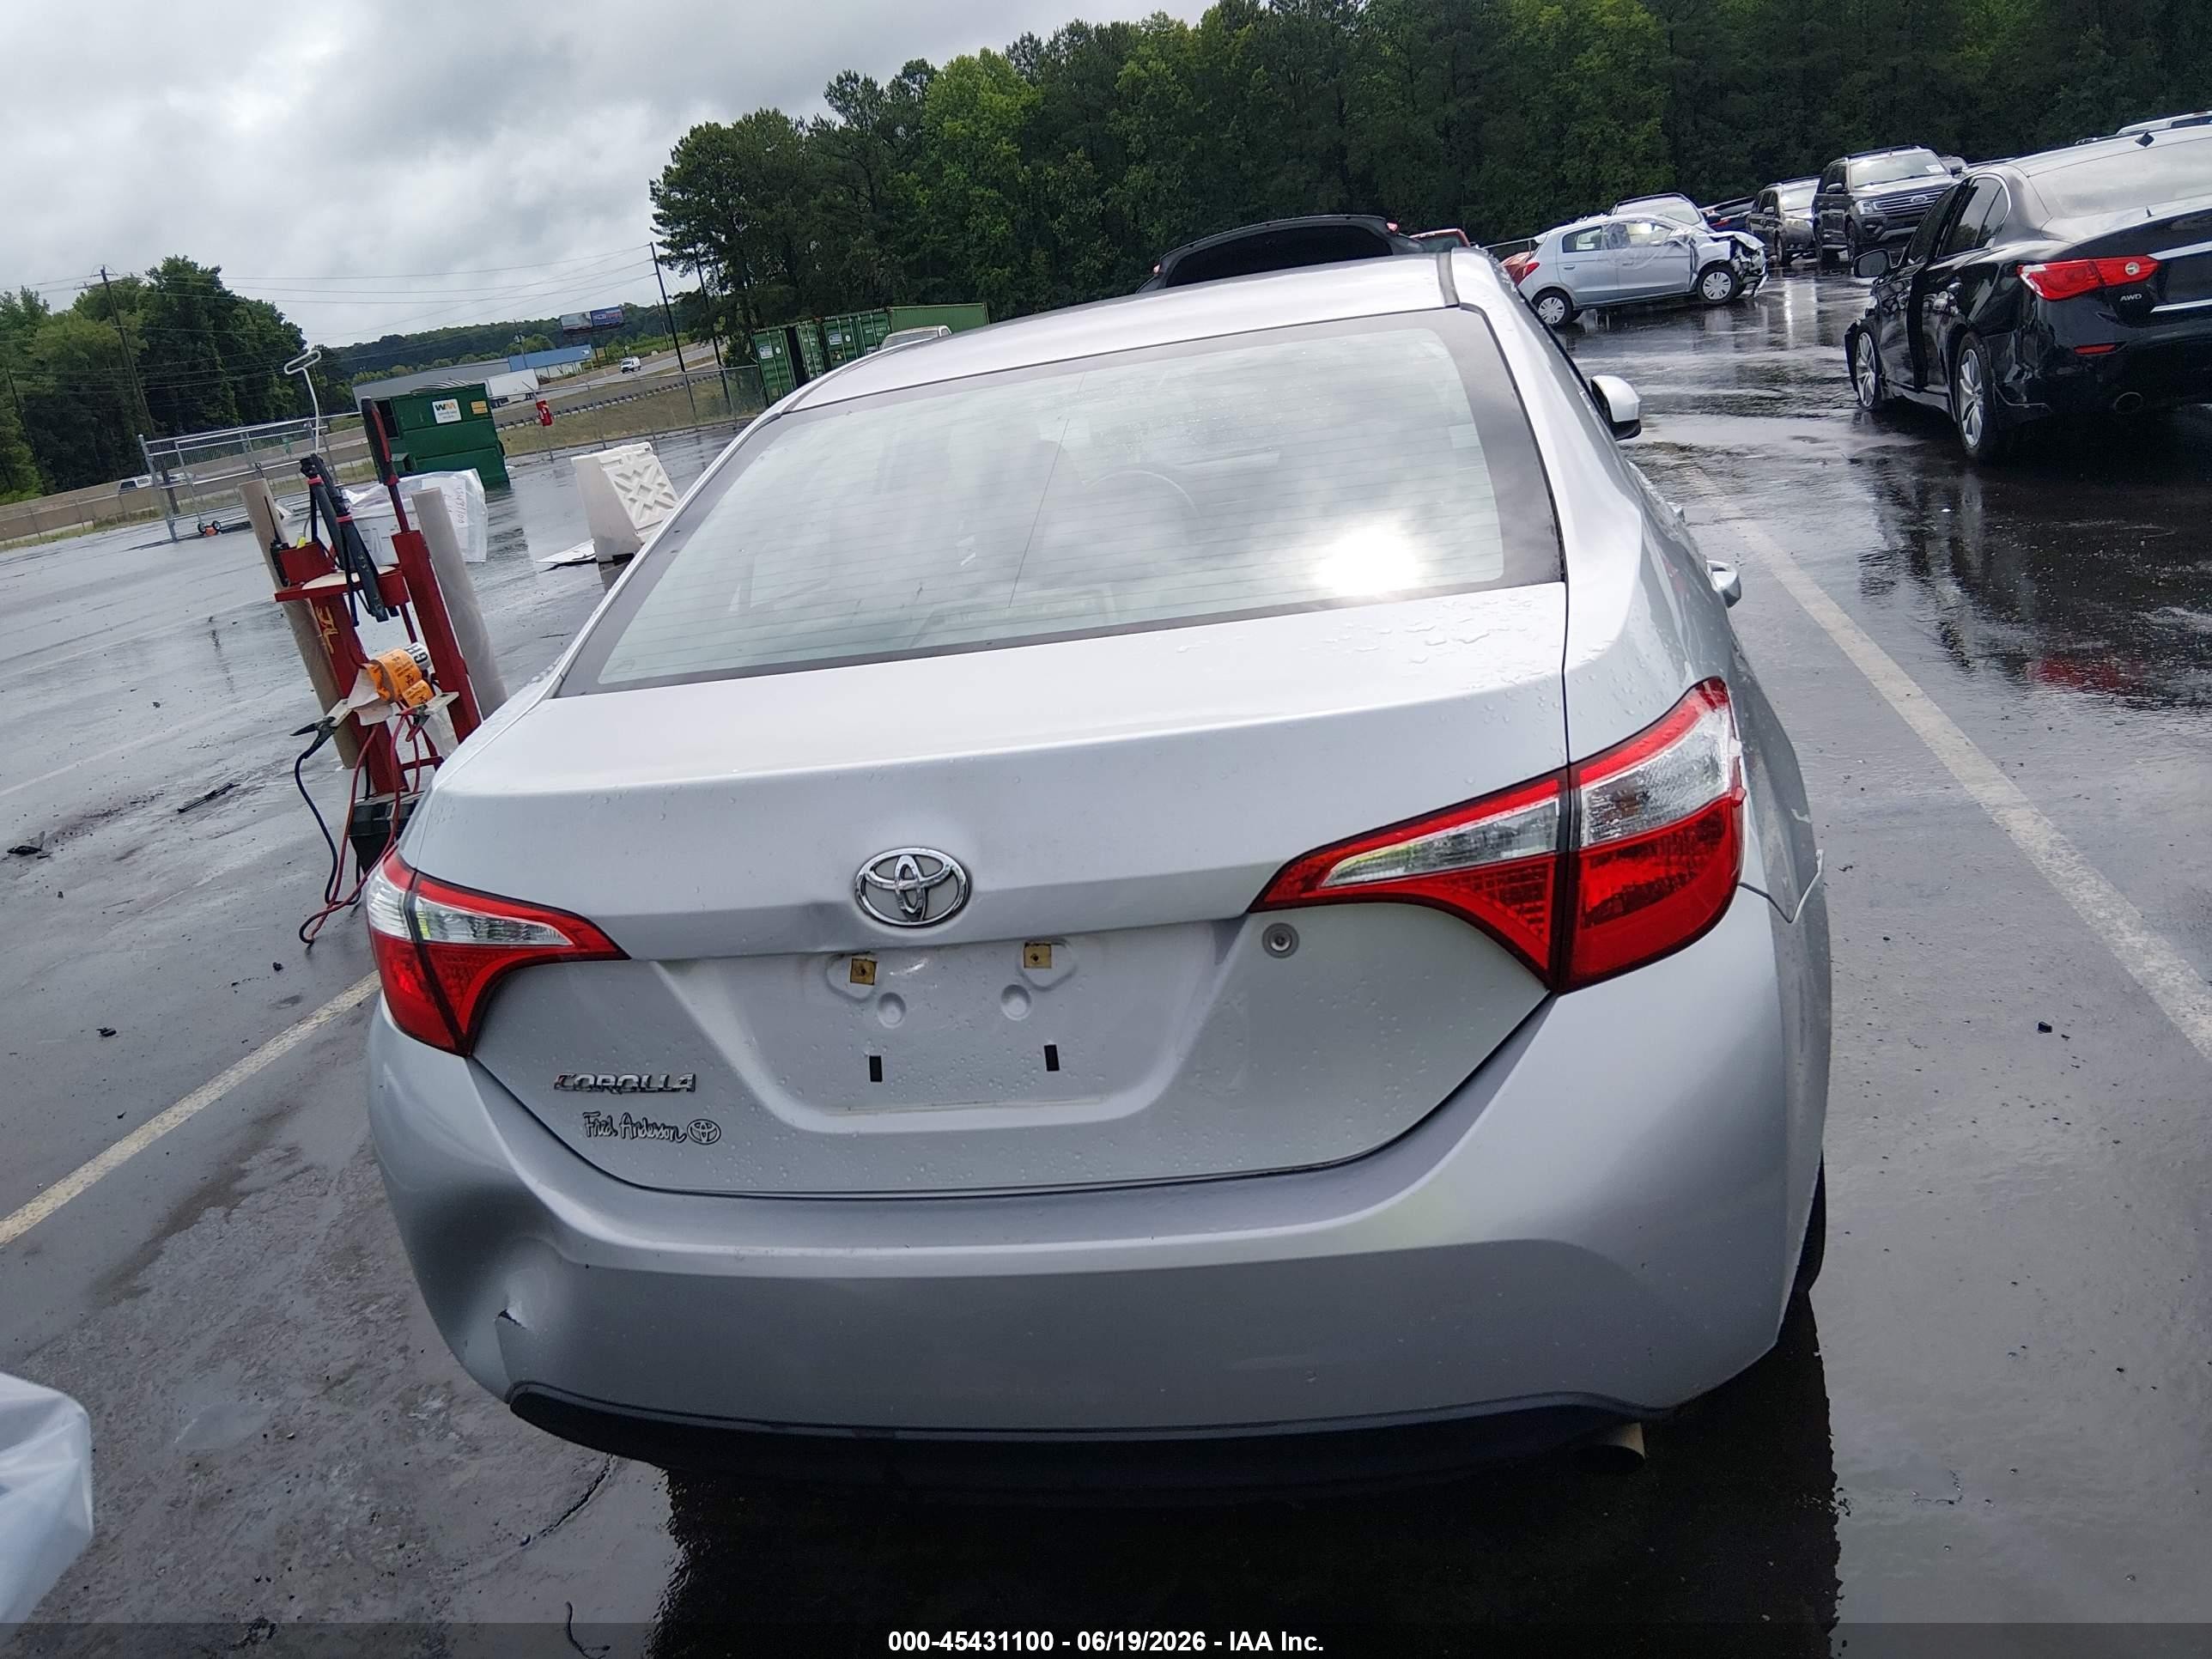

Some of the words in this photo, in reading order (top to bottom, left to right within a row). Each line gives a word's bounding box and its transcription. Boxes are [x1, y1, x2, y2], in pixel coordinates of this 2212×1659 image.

[434, 402, 457, 411] WM
[554, 1073, 696, 1095] COROLLA
[618, 1112, 688, 1143] Anderson
